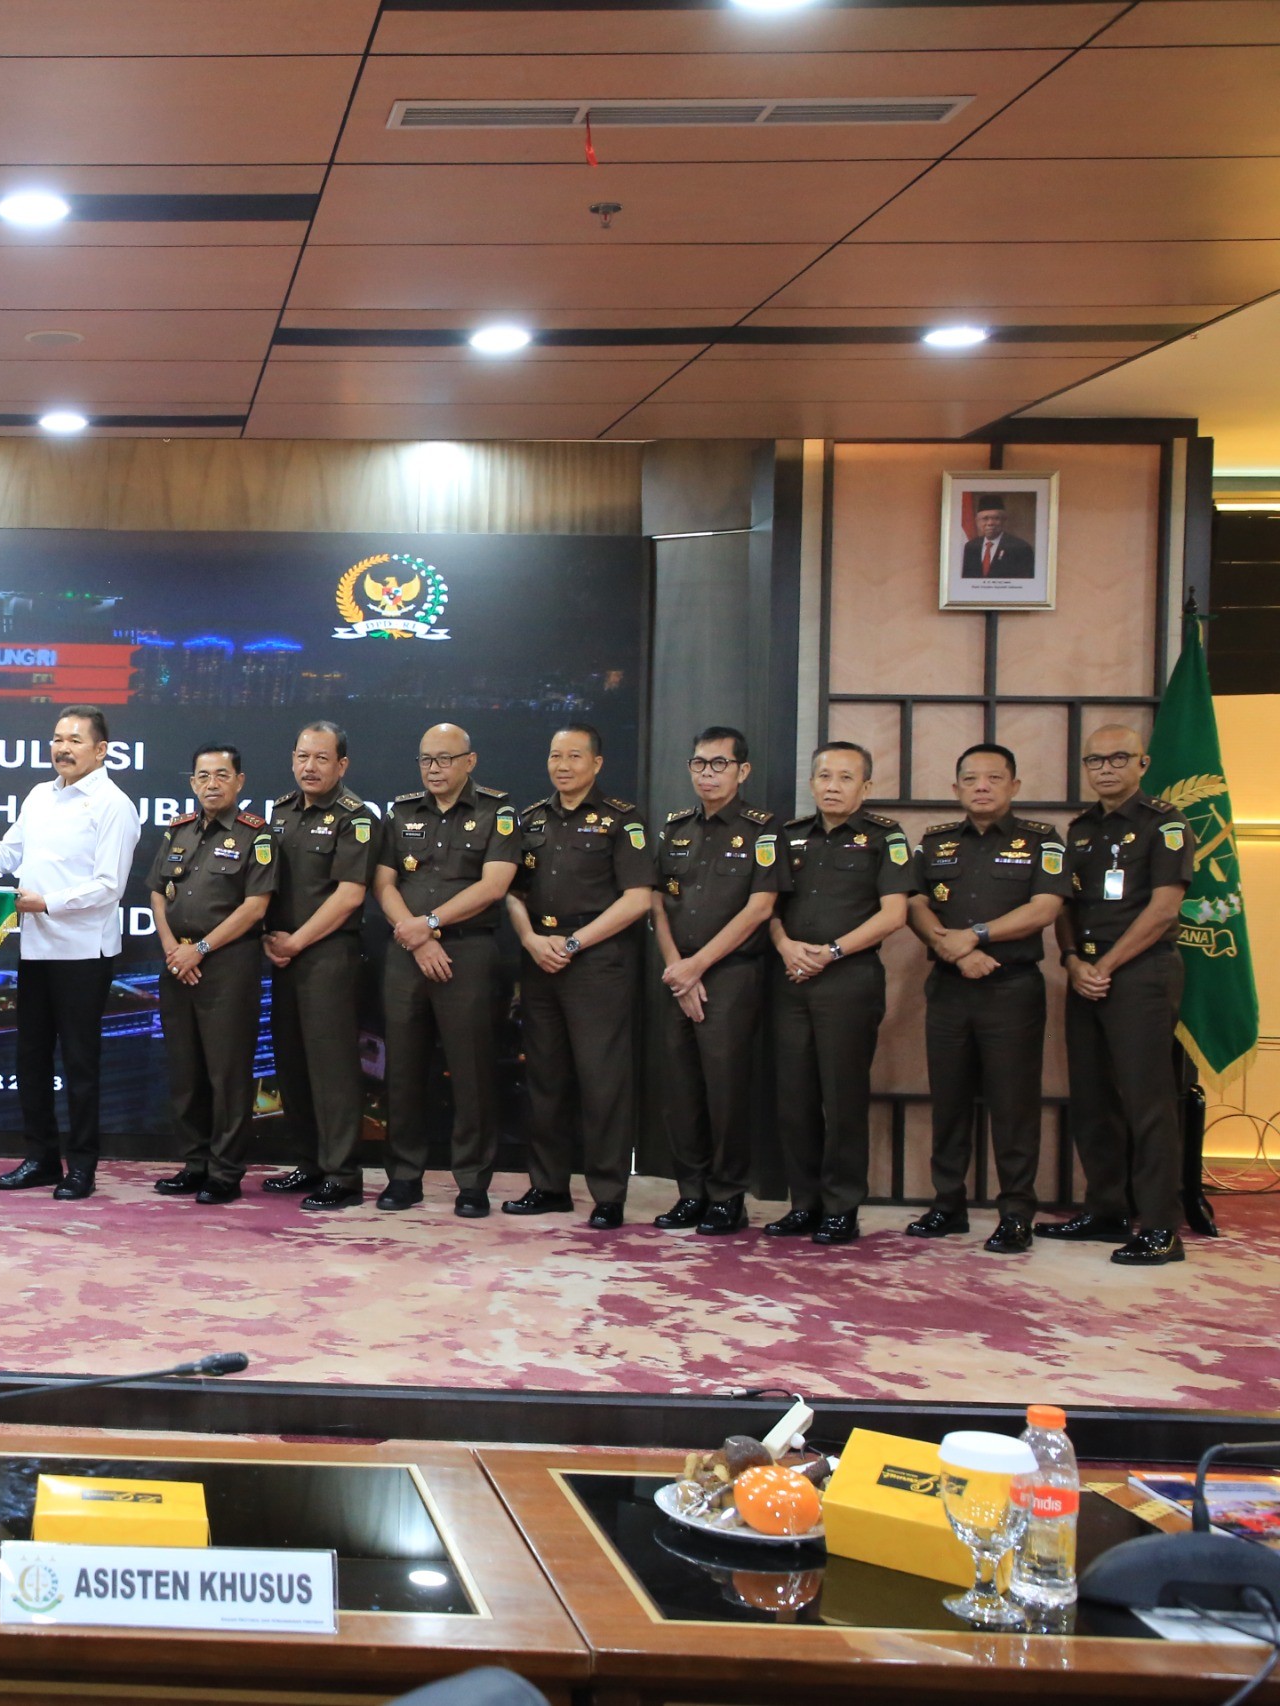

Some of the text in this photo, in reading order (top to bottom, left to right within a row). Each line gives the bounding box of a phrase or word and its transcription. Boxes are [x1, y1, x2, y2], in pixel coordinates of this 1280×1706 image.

[38, 651, 57, 666] RI
[74, 1568, 313, 1604] ASISTEN KHUSUS
